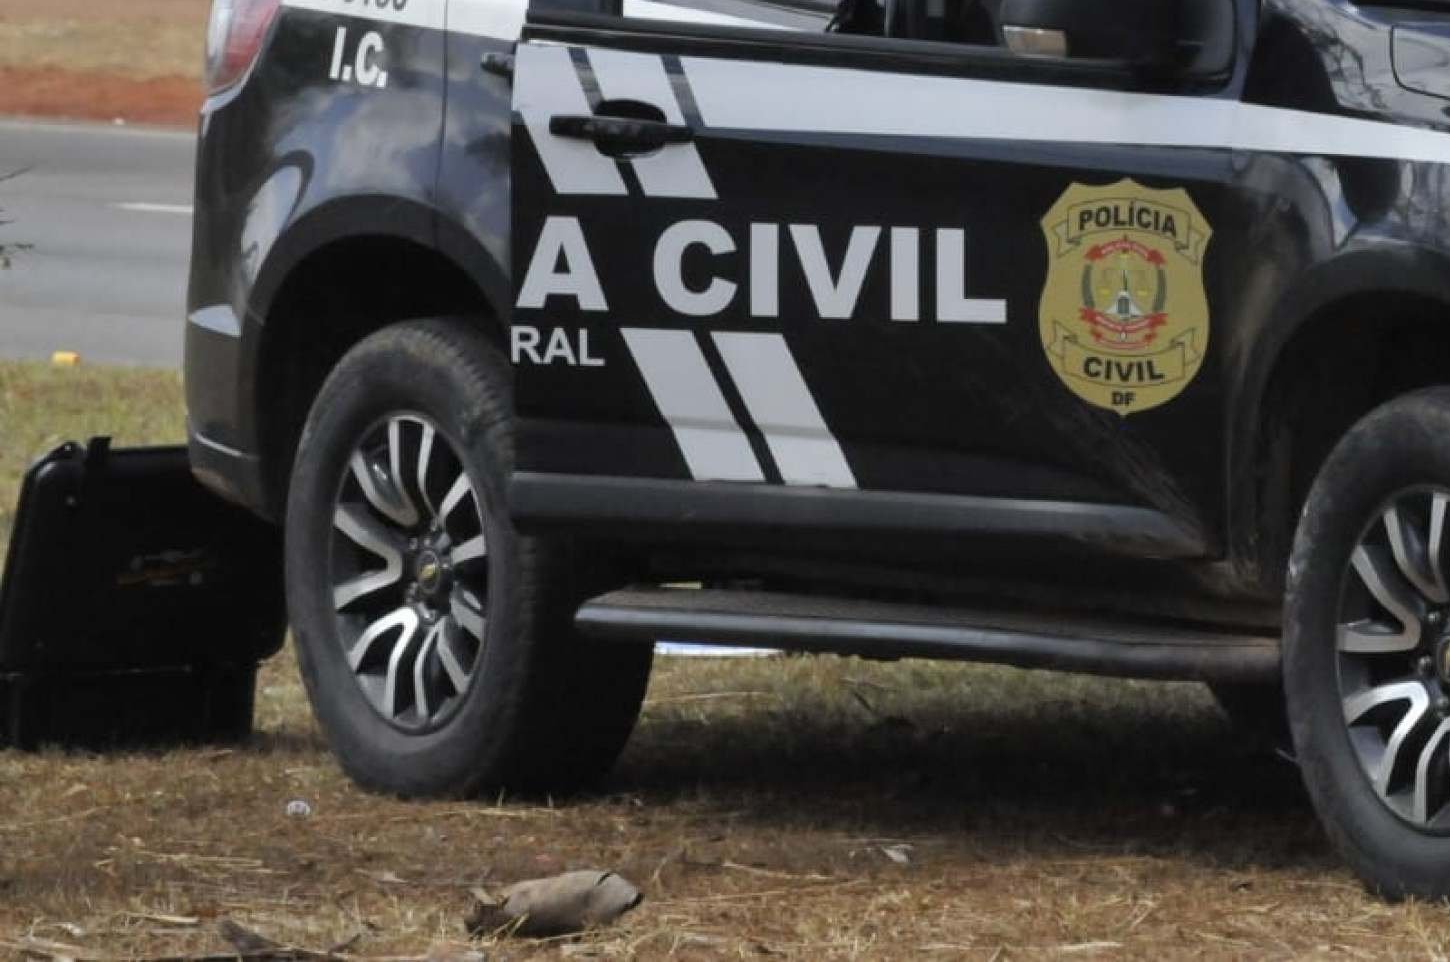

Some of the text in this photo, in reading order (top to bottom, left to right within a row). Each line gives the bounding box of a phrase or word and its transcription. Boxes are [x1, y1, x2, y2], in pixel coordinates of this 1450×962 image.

[329, 26, 388, 88] I.C.
[1079, 200, 1177, 236] POLÍCIA
[653, 219, 1007, 324] CIVIL
[1083, 356, 1165, 383] CIVIL
[1111, 391, 1136, 407] DF
